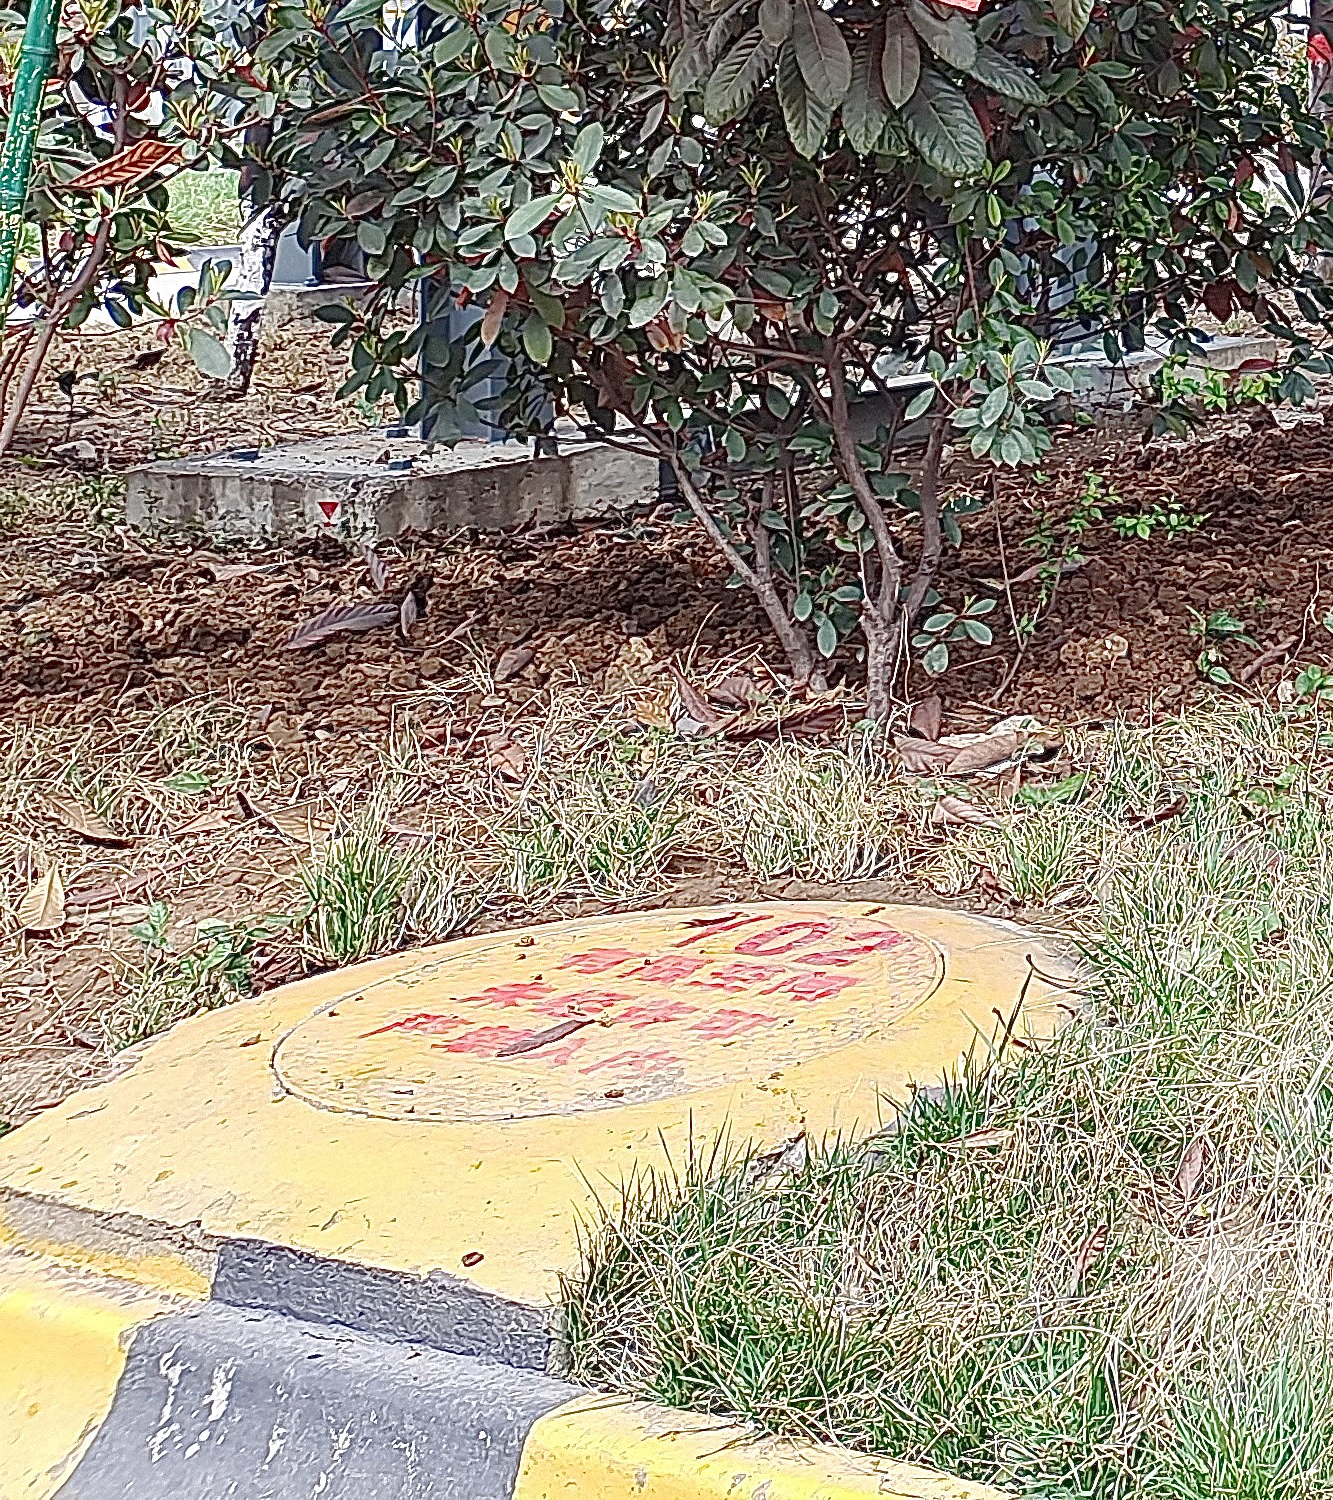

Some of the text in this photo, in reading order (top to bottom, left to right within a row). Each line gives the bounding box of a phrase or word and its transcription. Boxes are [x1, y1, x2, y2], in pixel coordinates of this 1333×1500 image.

[674, 914, 903, 967] 102
[555, 947, 866, 1002] 有限空间
[457, 982, 778, 1041] 未经许可
